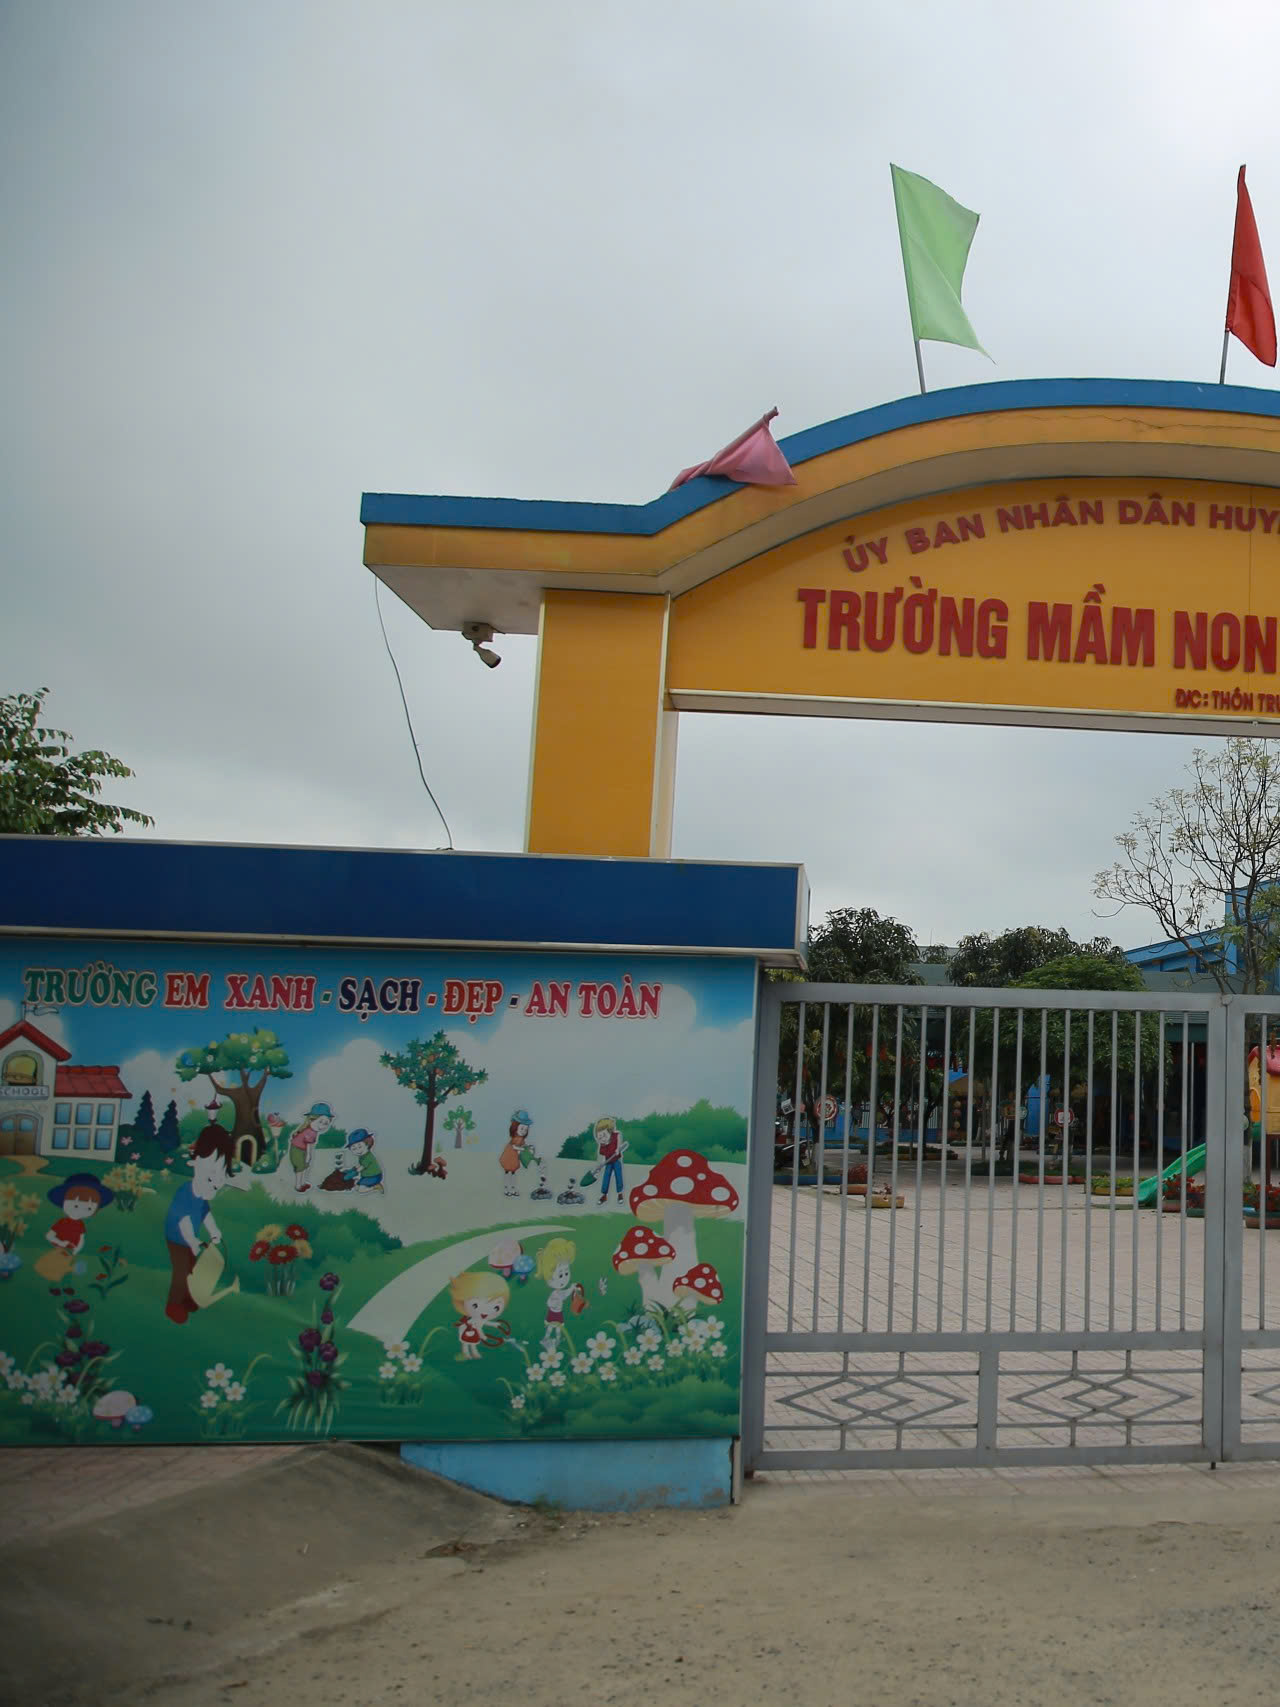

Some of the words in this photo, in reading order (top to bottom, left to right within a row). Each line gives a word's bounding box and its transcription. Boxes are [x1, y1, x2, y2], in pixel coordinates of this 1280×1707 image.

[842, 535, 889, 573] ỦY
[904, 513, 987, 555] BAN
[997, 495, 1105, 533] NHÂN
[1118, 493, 1196, 526] DÂN
[797, 576, 1009, 660] TRƯỜNG
[1027, 584, 1155, 667] MẦM
[1174, 610, 1277, 674] NON
[1211, 687, 1253, 711] THÔN
[24, 961, 158, 1007] TRƯỜNG
[164, 972, 210, 1008] EM
[225, 974, 317, 1010] XANH
[339, 977, 420, 1022] SẠCH
[443, 979, 503, 1023] ĐẸP
[525, 980, 571, 1016] AN
[578, 973, 662, 1018] TOÀN
